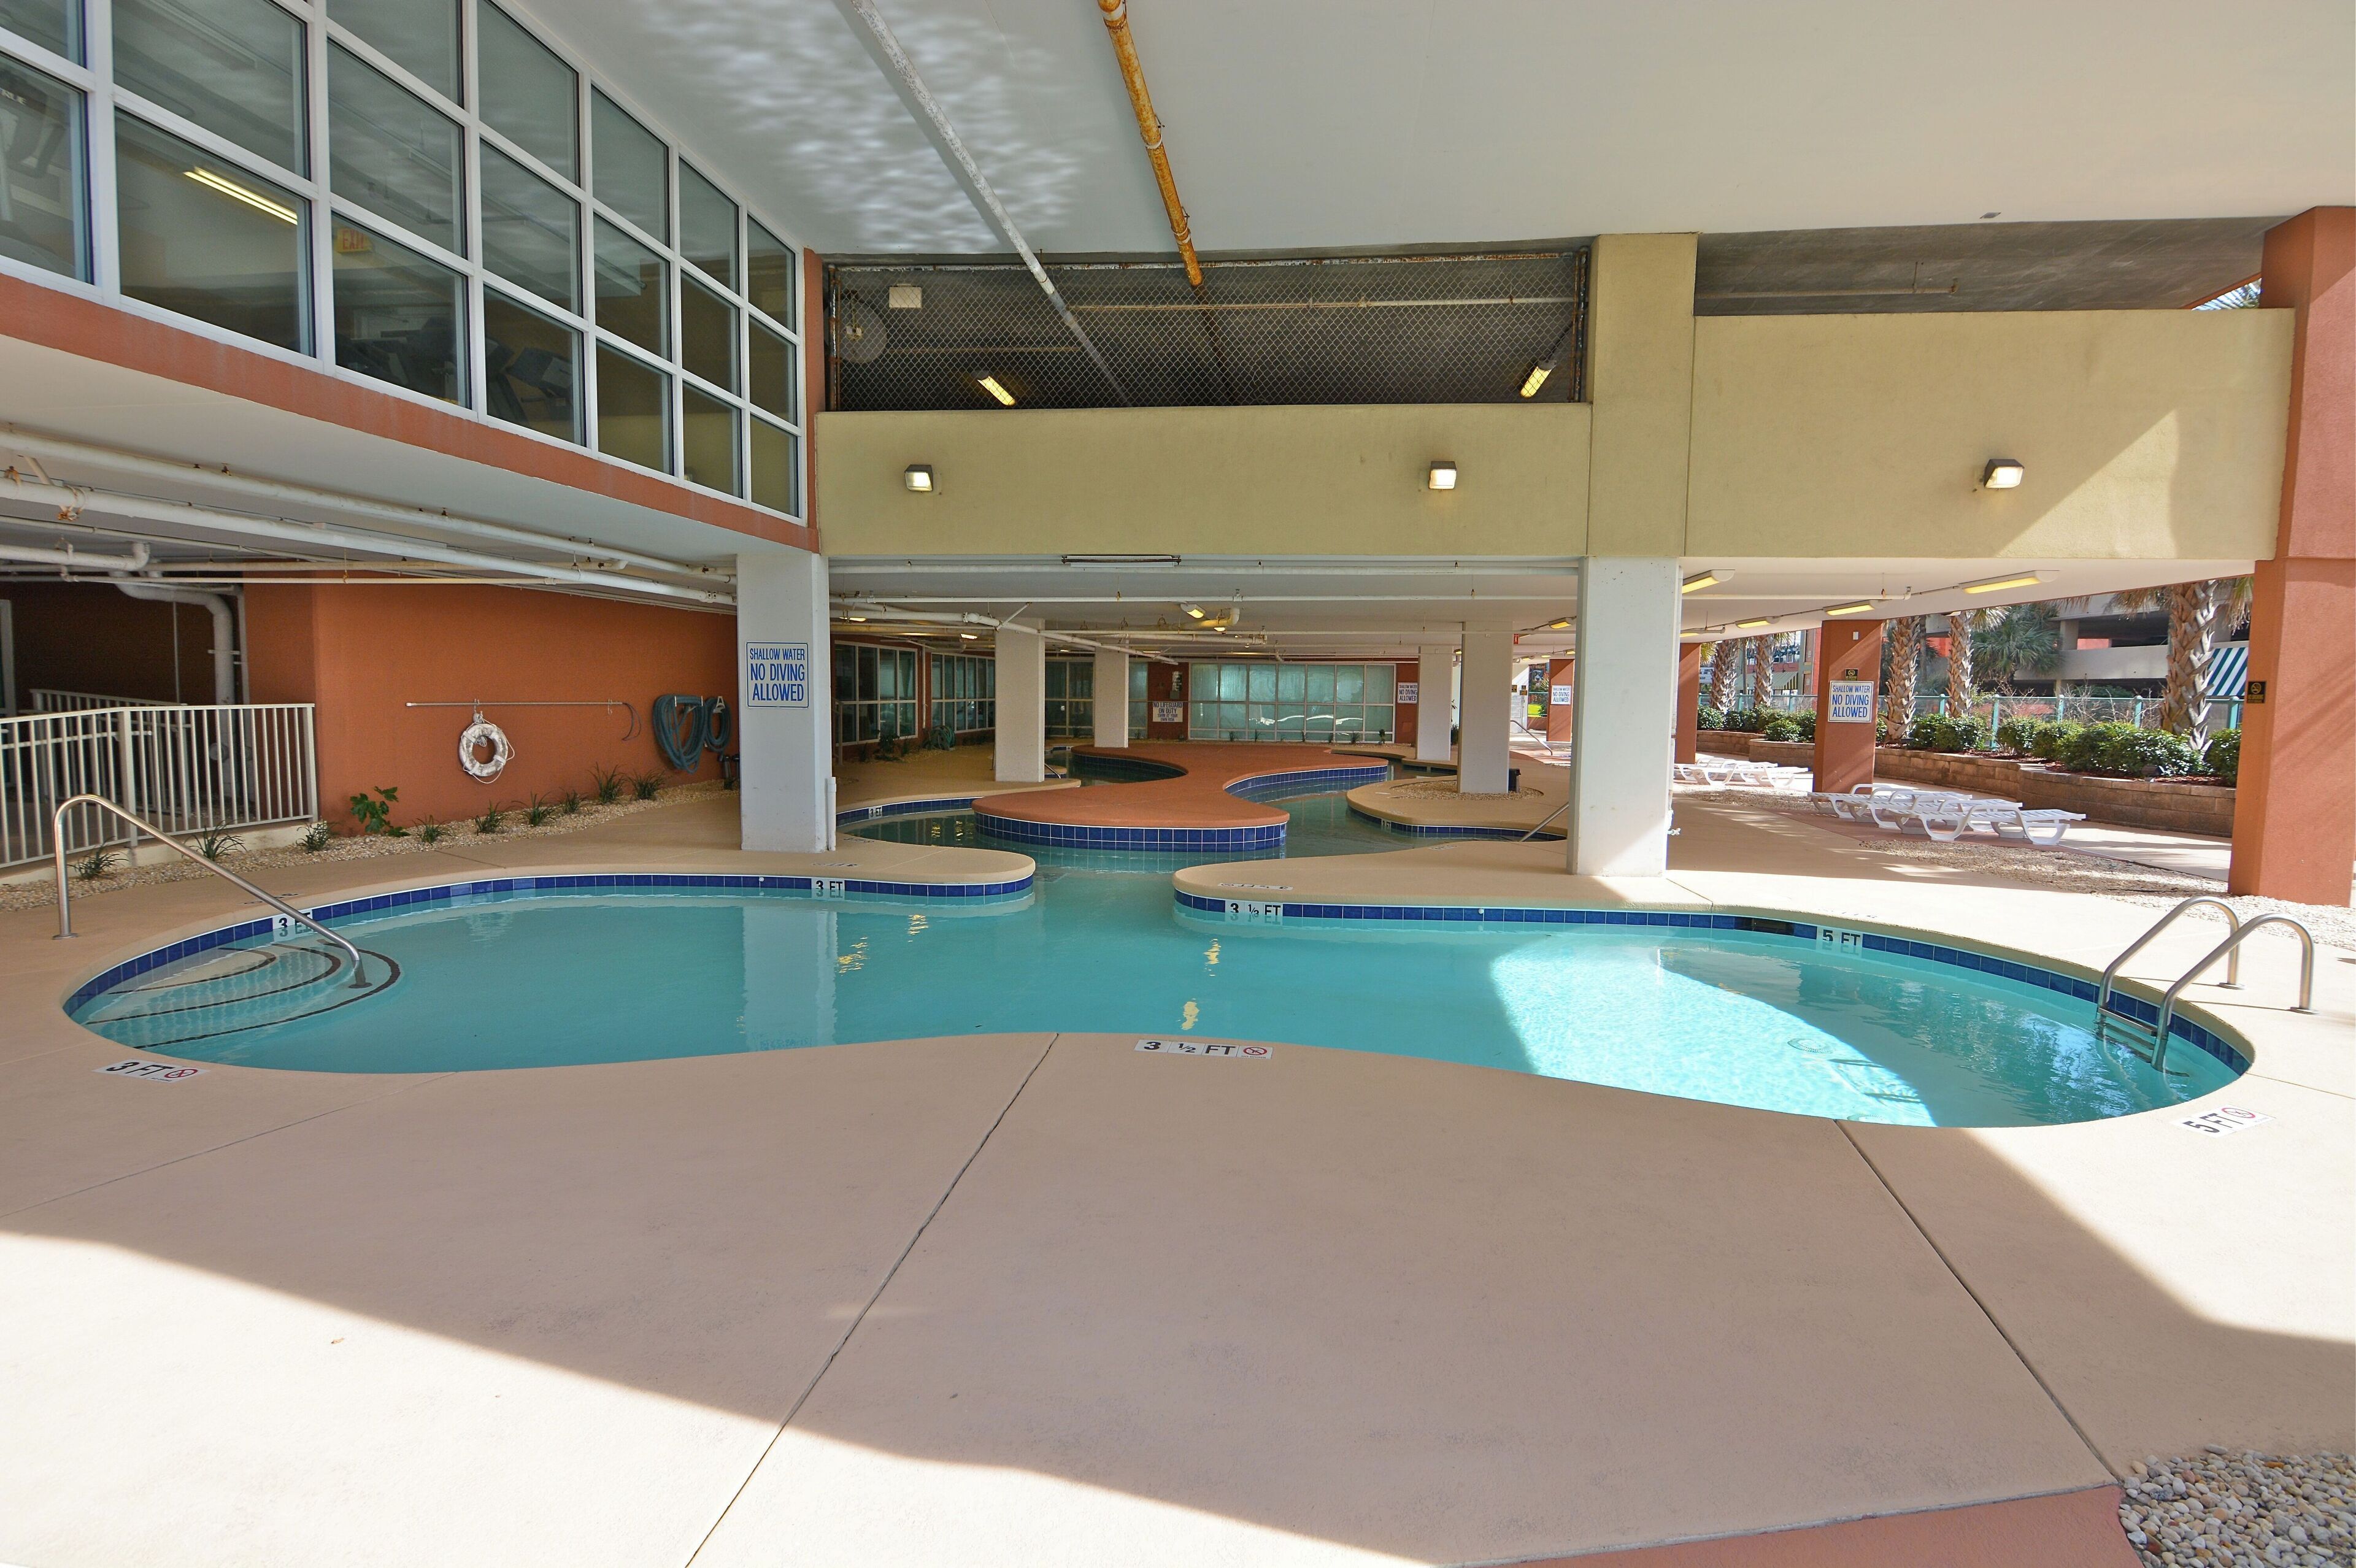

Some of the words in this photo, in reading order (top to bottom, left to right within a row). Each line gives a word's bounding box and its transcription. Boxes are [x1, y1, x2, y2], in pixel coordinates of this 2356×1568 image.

[750, 648, 780, 660] SHALLOW
[782, 648, 805, 660] WATER
[750, 663, 765, 680] NO
[770, 664, 805, 681] DIVING
[752, 683, 804, 701] ALLOWED
[1832, 694, 1842, 705] NO
[1846, 694, 1869, 705] DIVING
[1832, 707, 1868, 718] ALLOWED
[815, 880, 823, 890] 3
[830, 881, 842, 890] FT
[1230, 903, 1239, 913] 3
[1265, 905, 1280, 915] FT
[279, 918, 287, 928] 3
[1822, 929, 1833, 941] 5
[1841, 932, 1860, 945] FT
[1144, 1042, 1161, 1050] 3
[1205, 1045, 1236, 1055] FT
[106, 1062, 140, 1072] 3
[125, 1064, 175, 1076] FT
[2199, 1113, 2244, 1128] FT
[2182, 1121, 2220, 1133] 5
